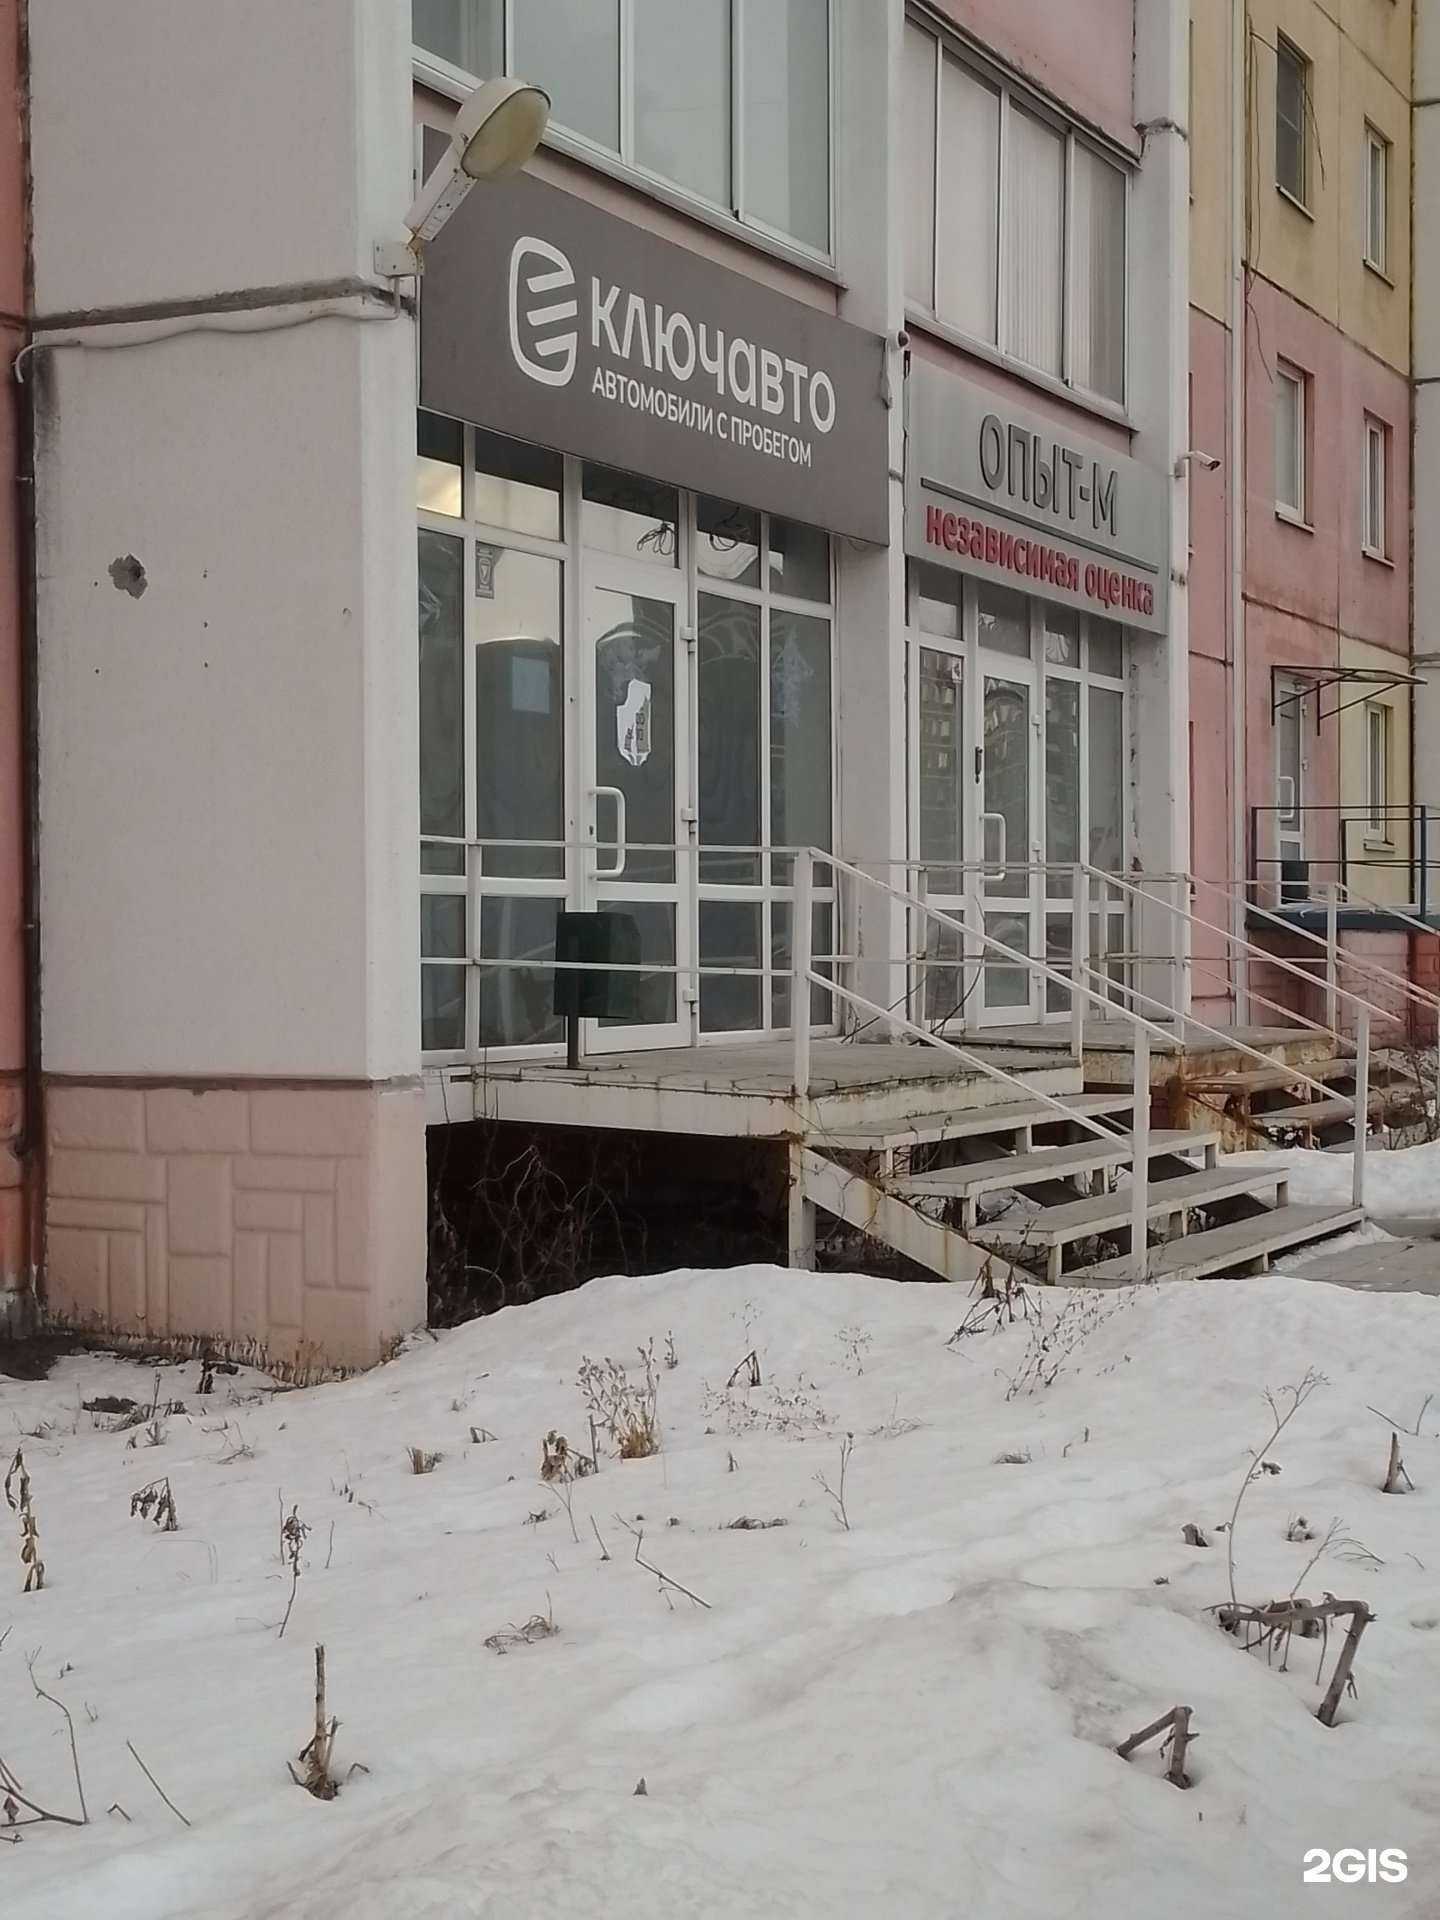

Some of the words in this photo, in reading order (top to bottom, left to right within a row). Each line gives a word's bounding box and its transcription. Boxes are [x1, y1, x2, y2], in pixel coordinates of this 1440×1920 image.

[592, 367, 714, 434] АВТОМОБИЛИ
[717, 412, 728, 439] С
[731, 420, 812, 467] ПРОБЕГОМ
[980, 414, 1118, 536] ОПЫТ-М
[1085, 564, 1154, 615] оценка
